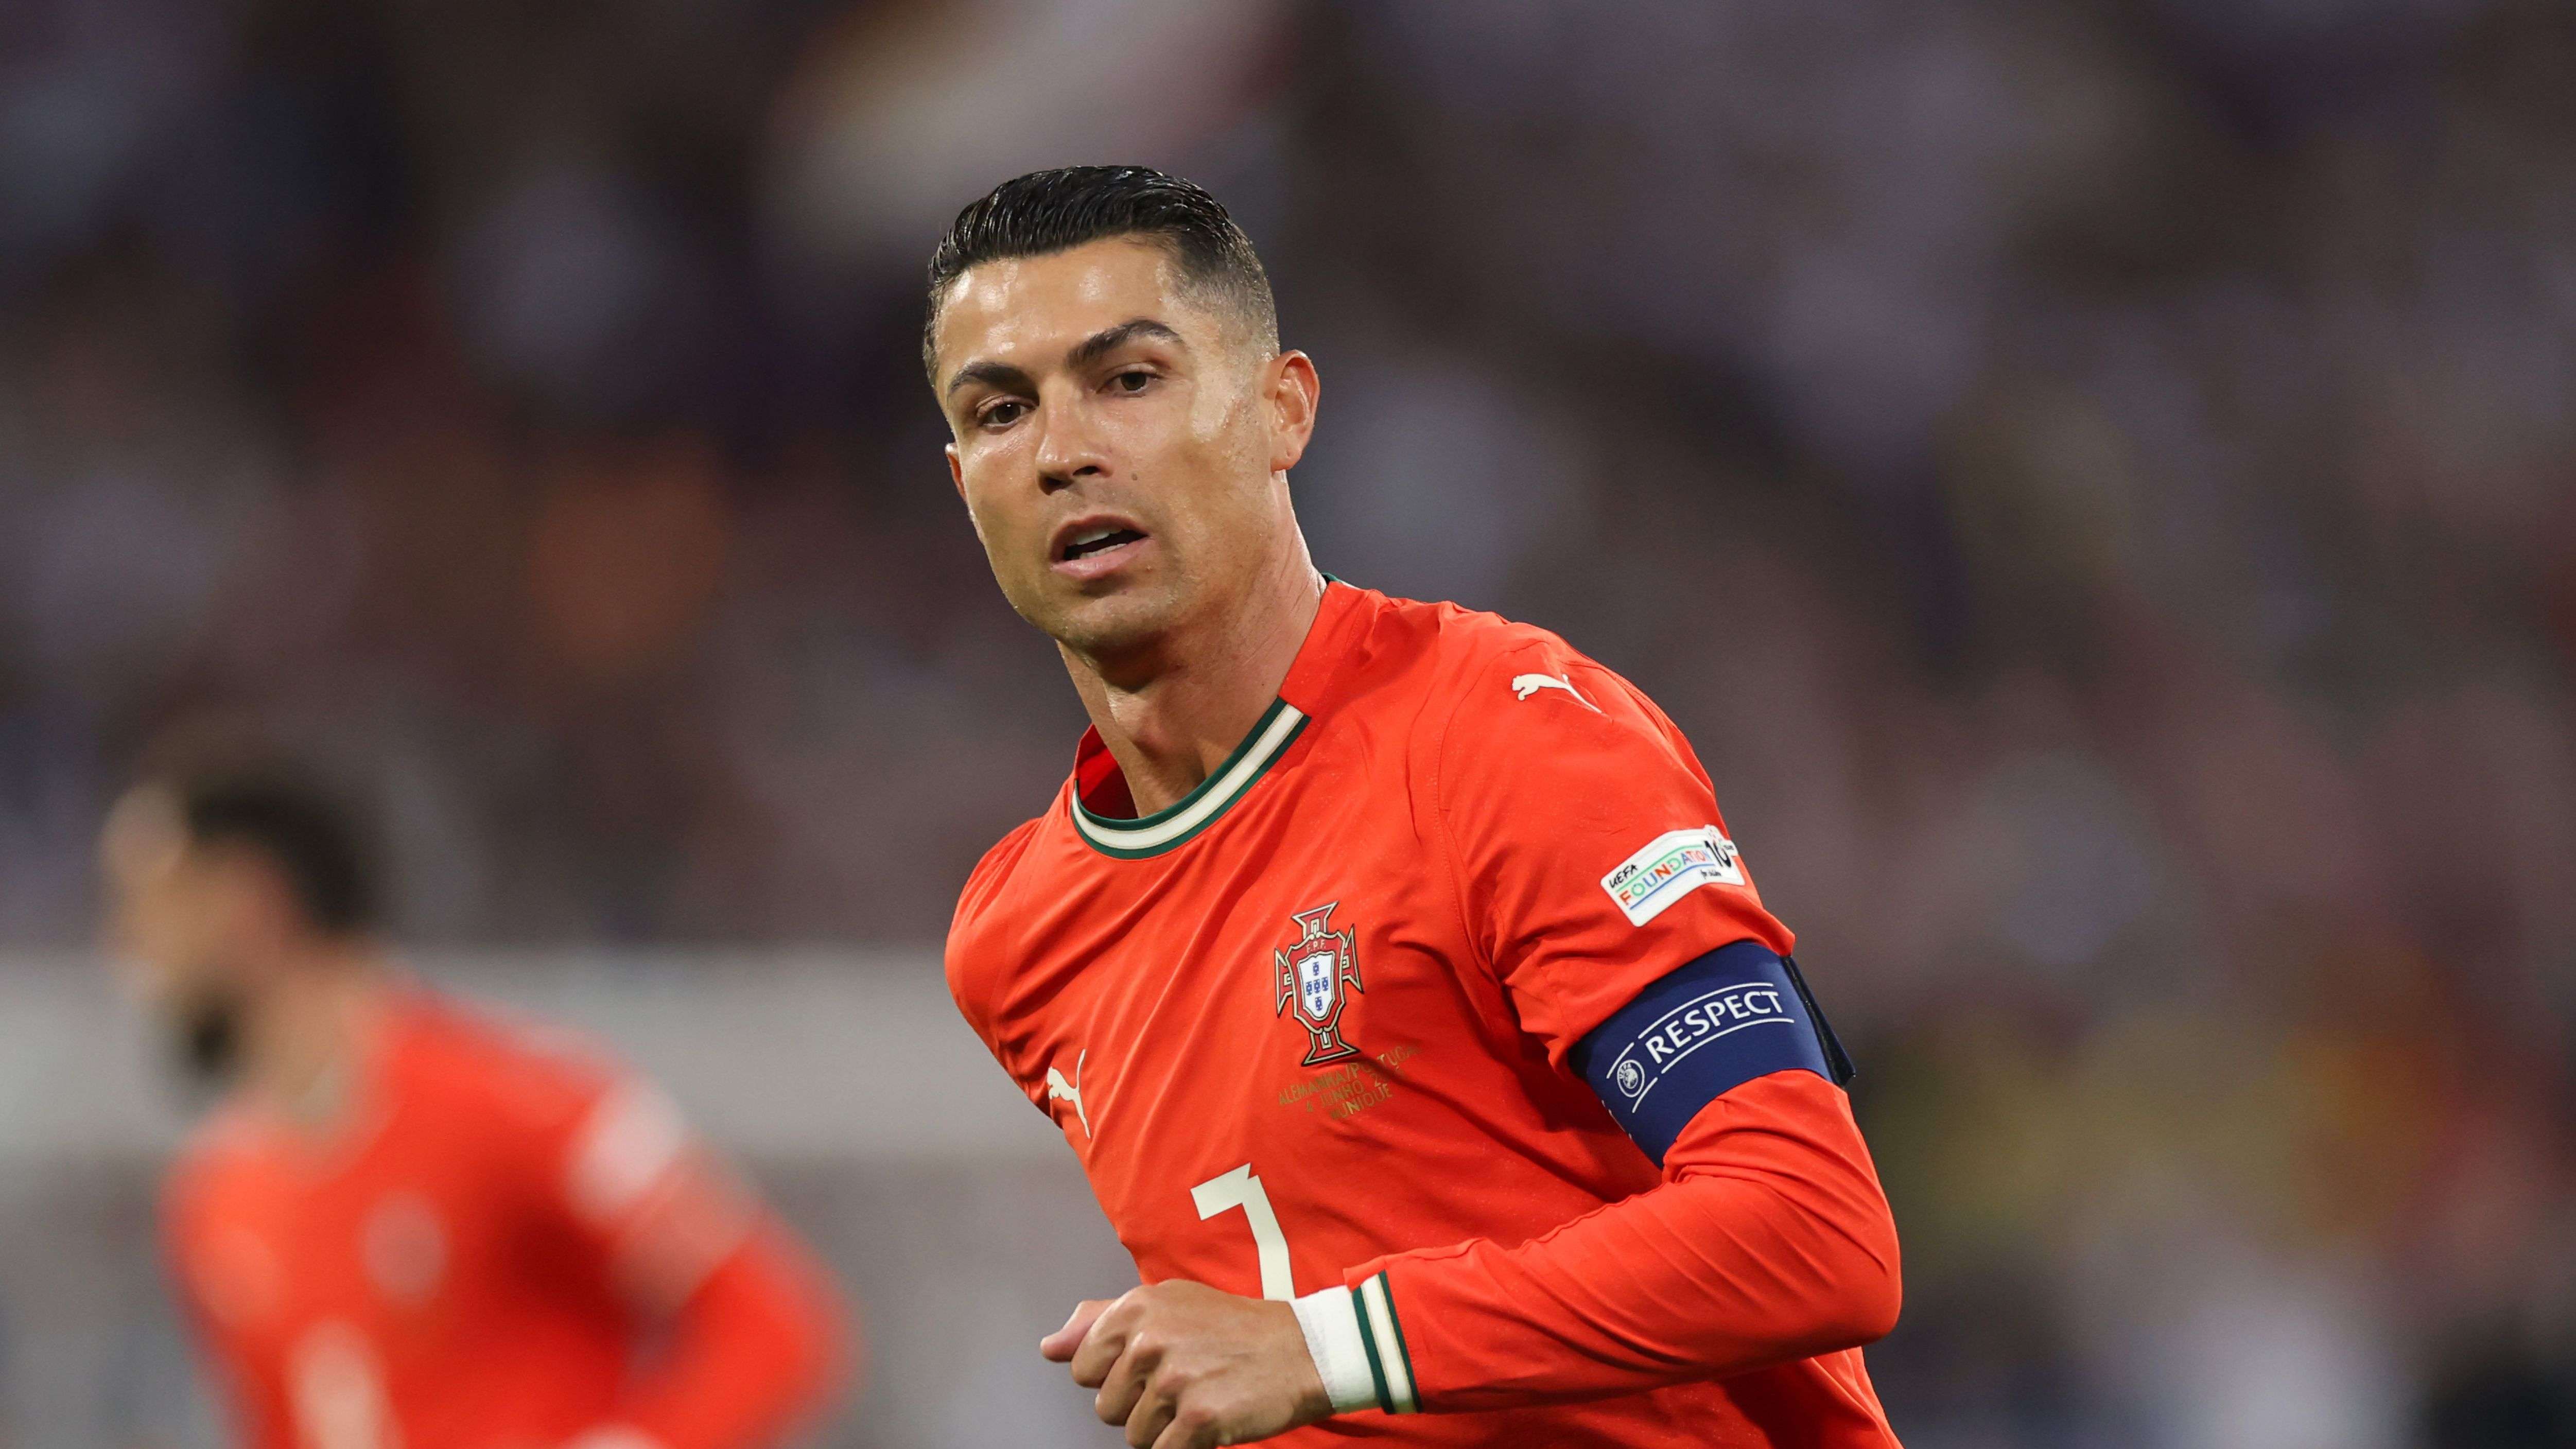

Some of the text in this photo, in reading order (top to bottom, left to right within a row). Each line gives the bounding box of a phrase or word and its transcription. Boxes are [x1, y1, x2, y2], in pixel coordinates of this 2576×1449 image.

[1609, 864, 1639, 889] UEFA
[1619, 849, 1713, 905] FOUNDATION
[1645, 991, 1783, 1064] RESPECT
[1619, 1062, 1632, 1079] UEFA
[1190, 1162, 1295, 1301] 7
